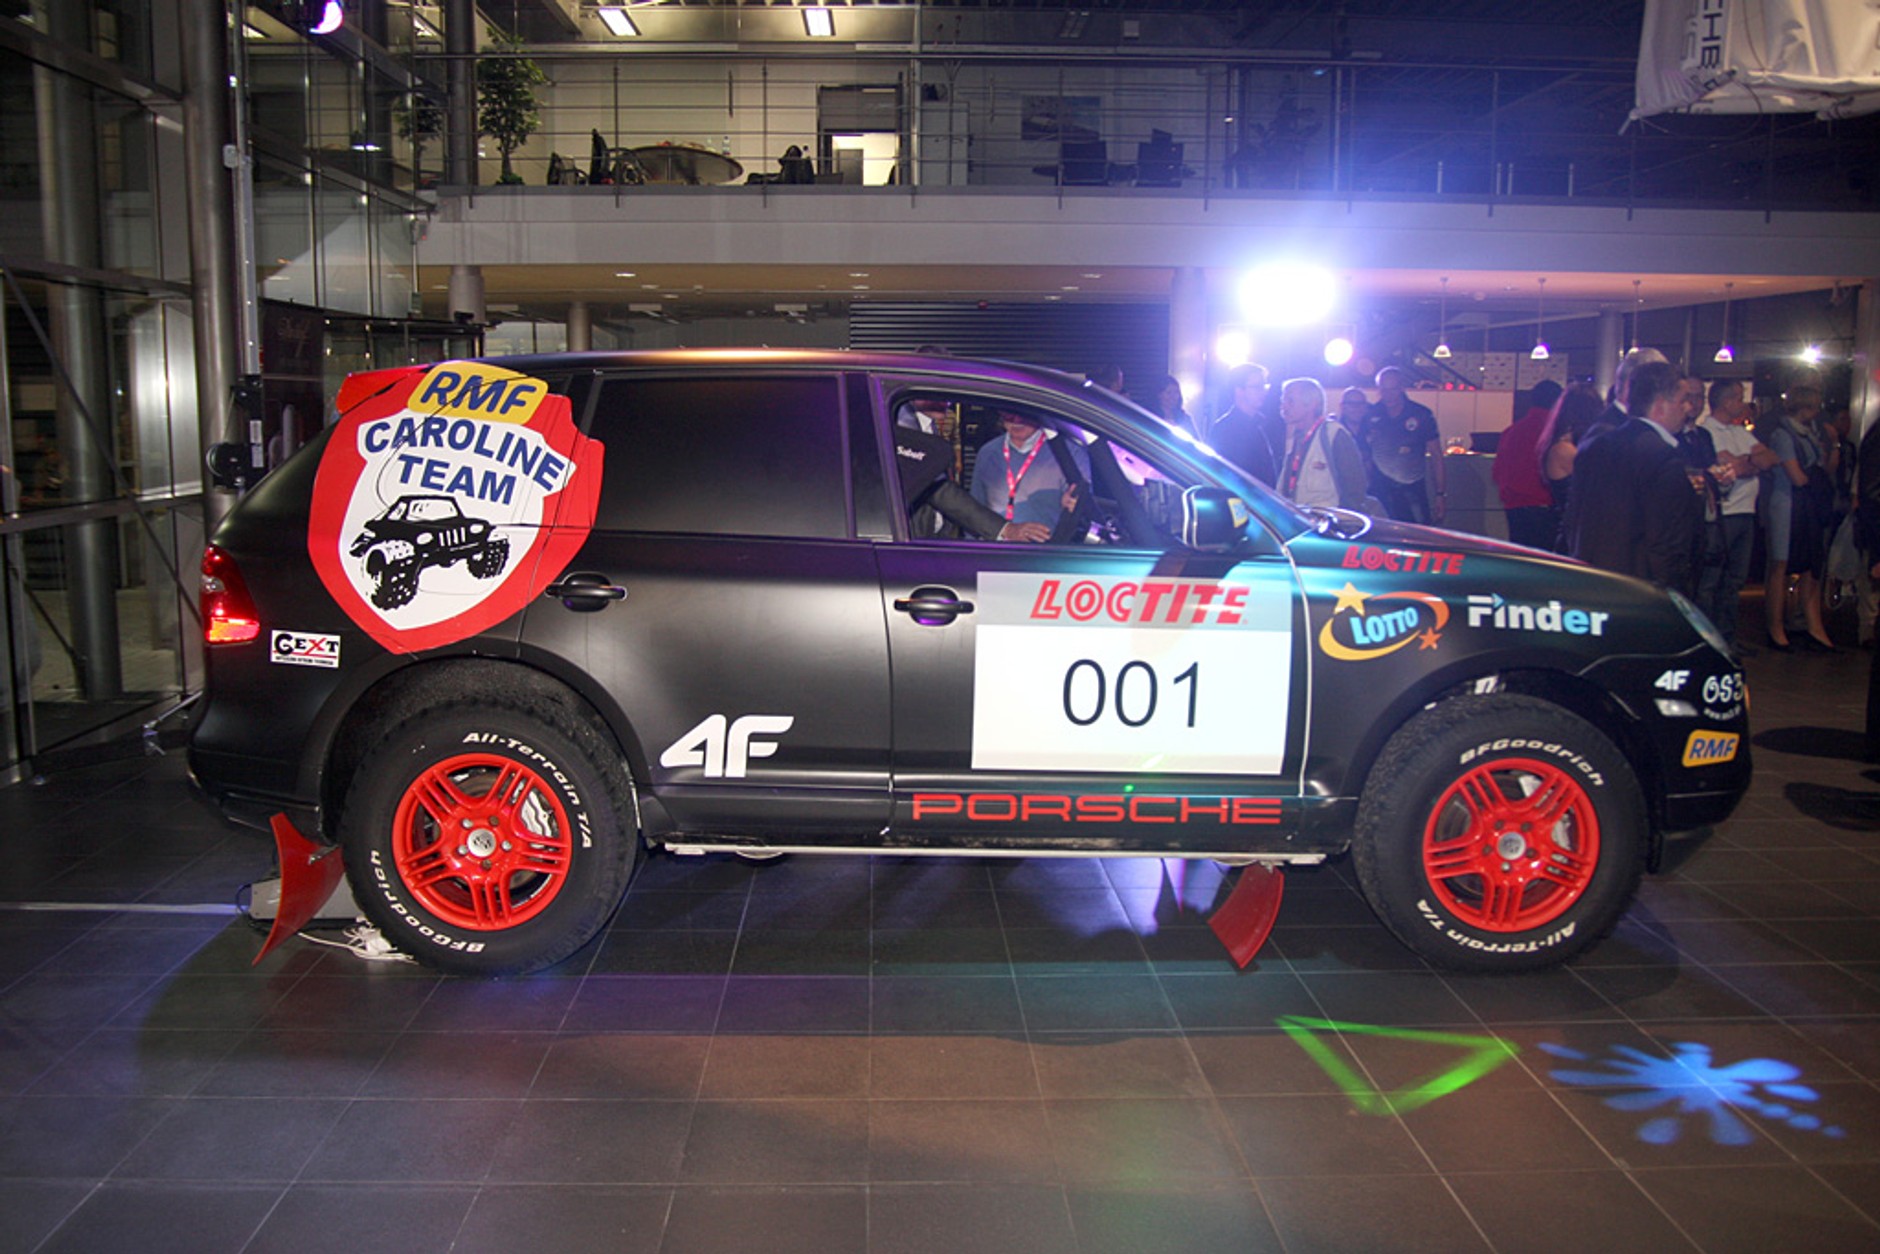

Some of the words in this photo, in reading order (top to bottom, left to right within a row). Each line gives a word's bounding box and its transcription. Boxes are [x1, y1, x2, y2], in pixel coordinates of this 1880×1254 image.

[420, 371, 537, 415] RMF
[365, 417, 565, 491] CAROLINE
[398, 453, 517, 505] TEAM
[1341, 546, 1465, 575] LOCTITE
[1030, 580, 1250, 624] LOCTITE
[1467, 593, 1609, 636] Finder
[275, 633, 339, 655] GEXT
[1350, 606, 1419, 646] LOTTO
[1063, 659, 1199, 728] 001
[1654, 670, 1690, 691] 4F
[660, 713, 794, 777] 4F
[1460, 738, 1604, 786] BFGoodrich
[1689, 737, 1737, 760] RMF
[462, 732, 580, 806] All-Terrain
[577, 811, 593, 848] T/A
[912, 793, 1283, 824] PORSCHE
[370, 849, 486, 953] BFGoodrich
[1416, 899, 1445, 931] T/A
[1446, 921, 1577, 954] All-Terrain
